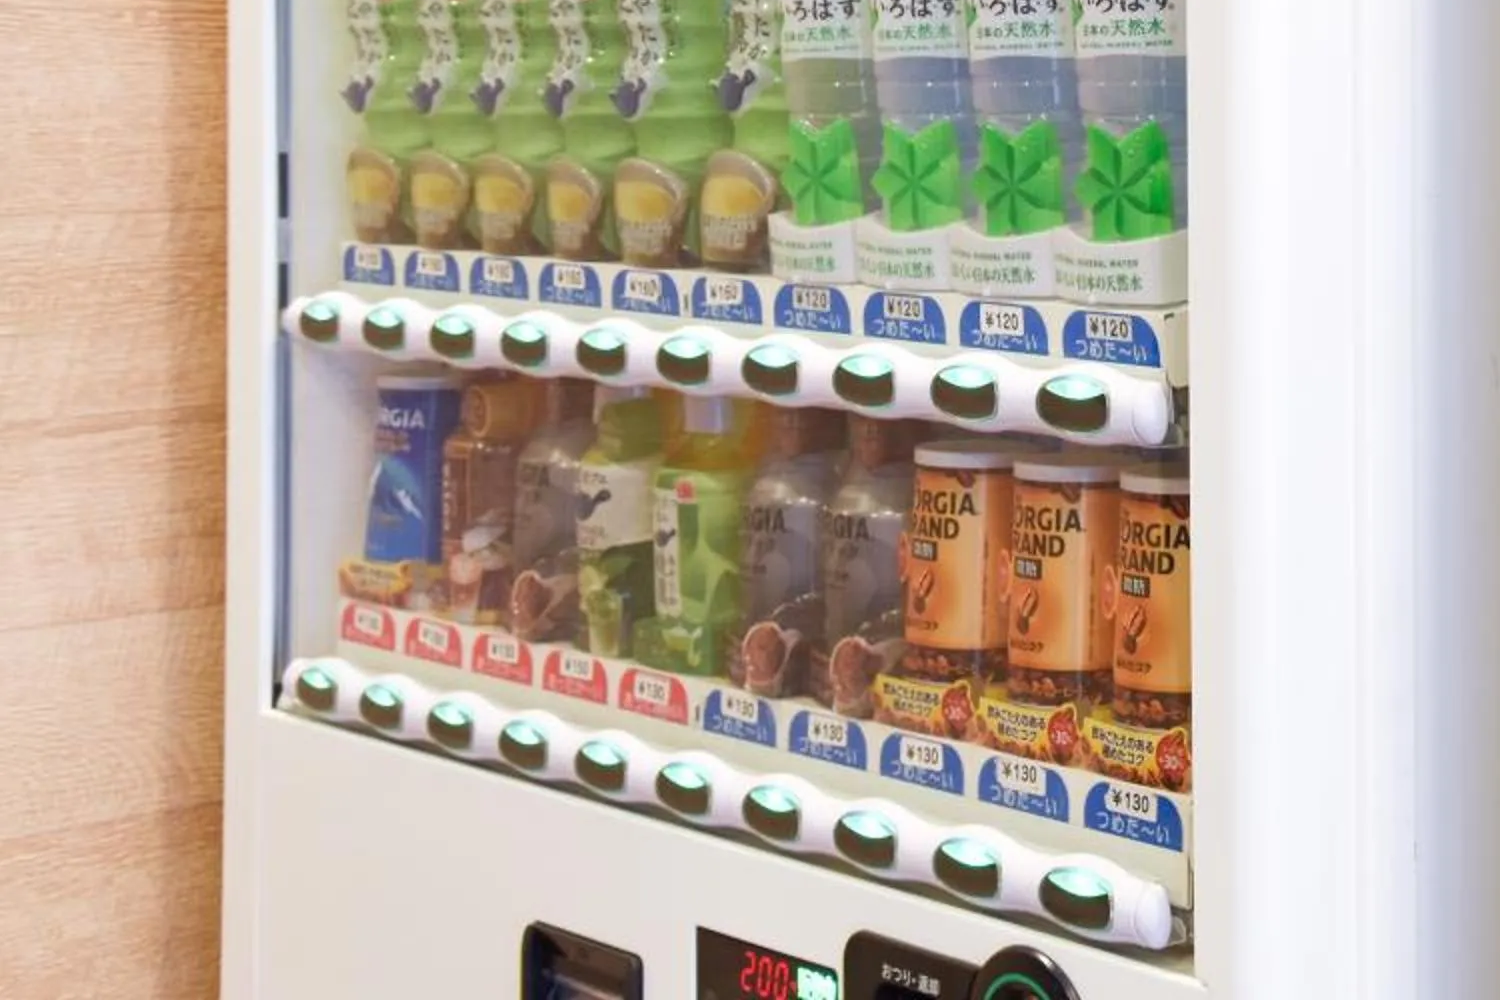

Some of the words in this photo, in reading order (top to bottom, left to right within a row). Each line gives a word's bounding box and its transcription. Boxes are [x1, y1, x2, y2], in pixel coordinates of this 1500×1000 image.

[795, 290, 827, 309] ¥120
[887, 297, 921, 317] ¥120
[985, 312, 1019, 332] ¥120
[1088, 317, 1129, 339] ¥120
[1074, 339, 1148, 362] つめた〜い
[812, 721, 844, 743] ¥130
[905, 743, 940, 766] ¥130
[1002, 761, 1037, 784] ¥130
[1111, 788, 1150, 814] ¥130
[739, 952, 790, 1000] 200
